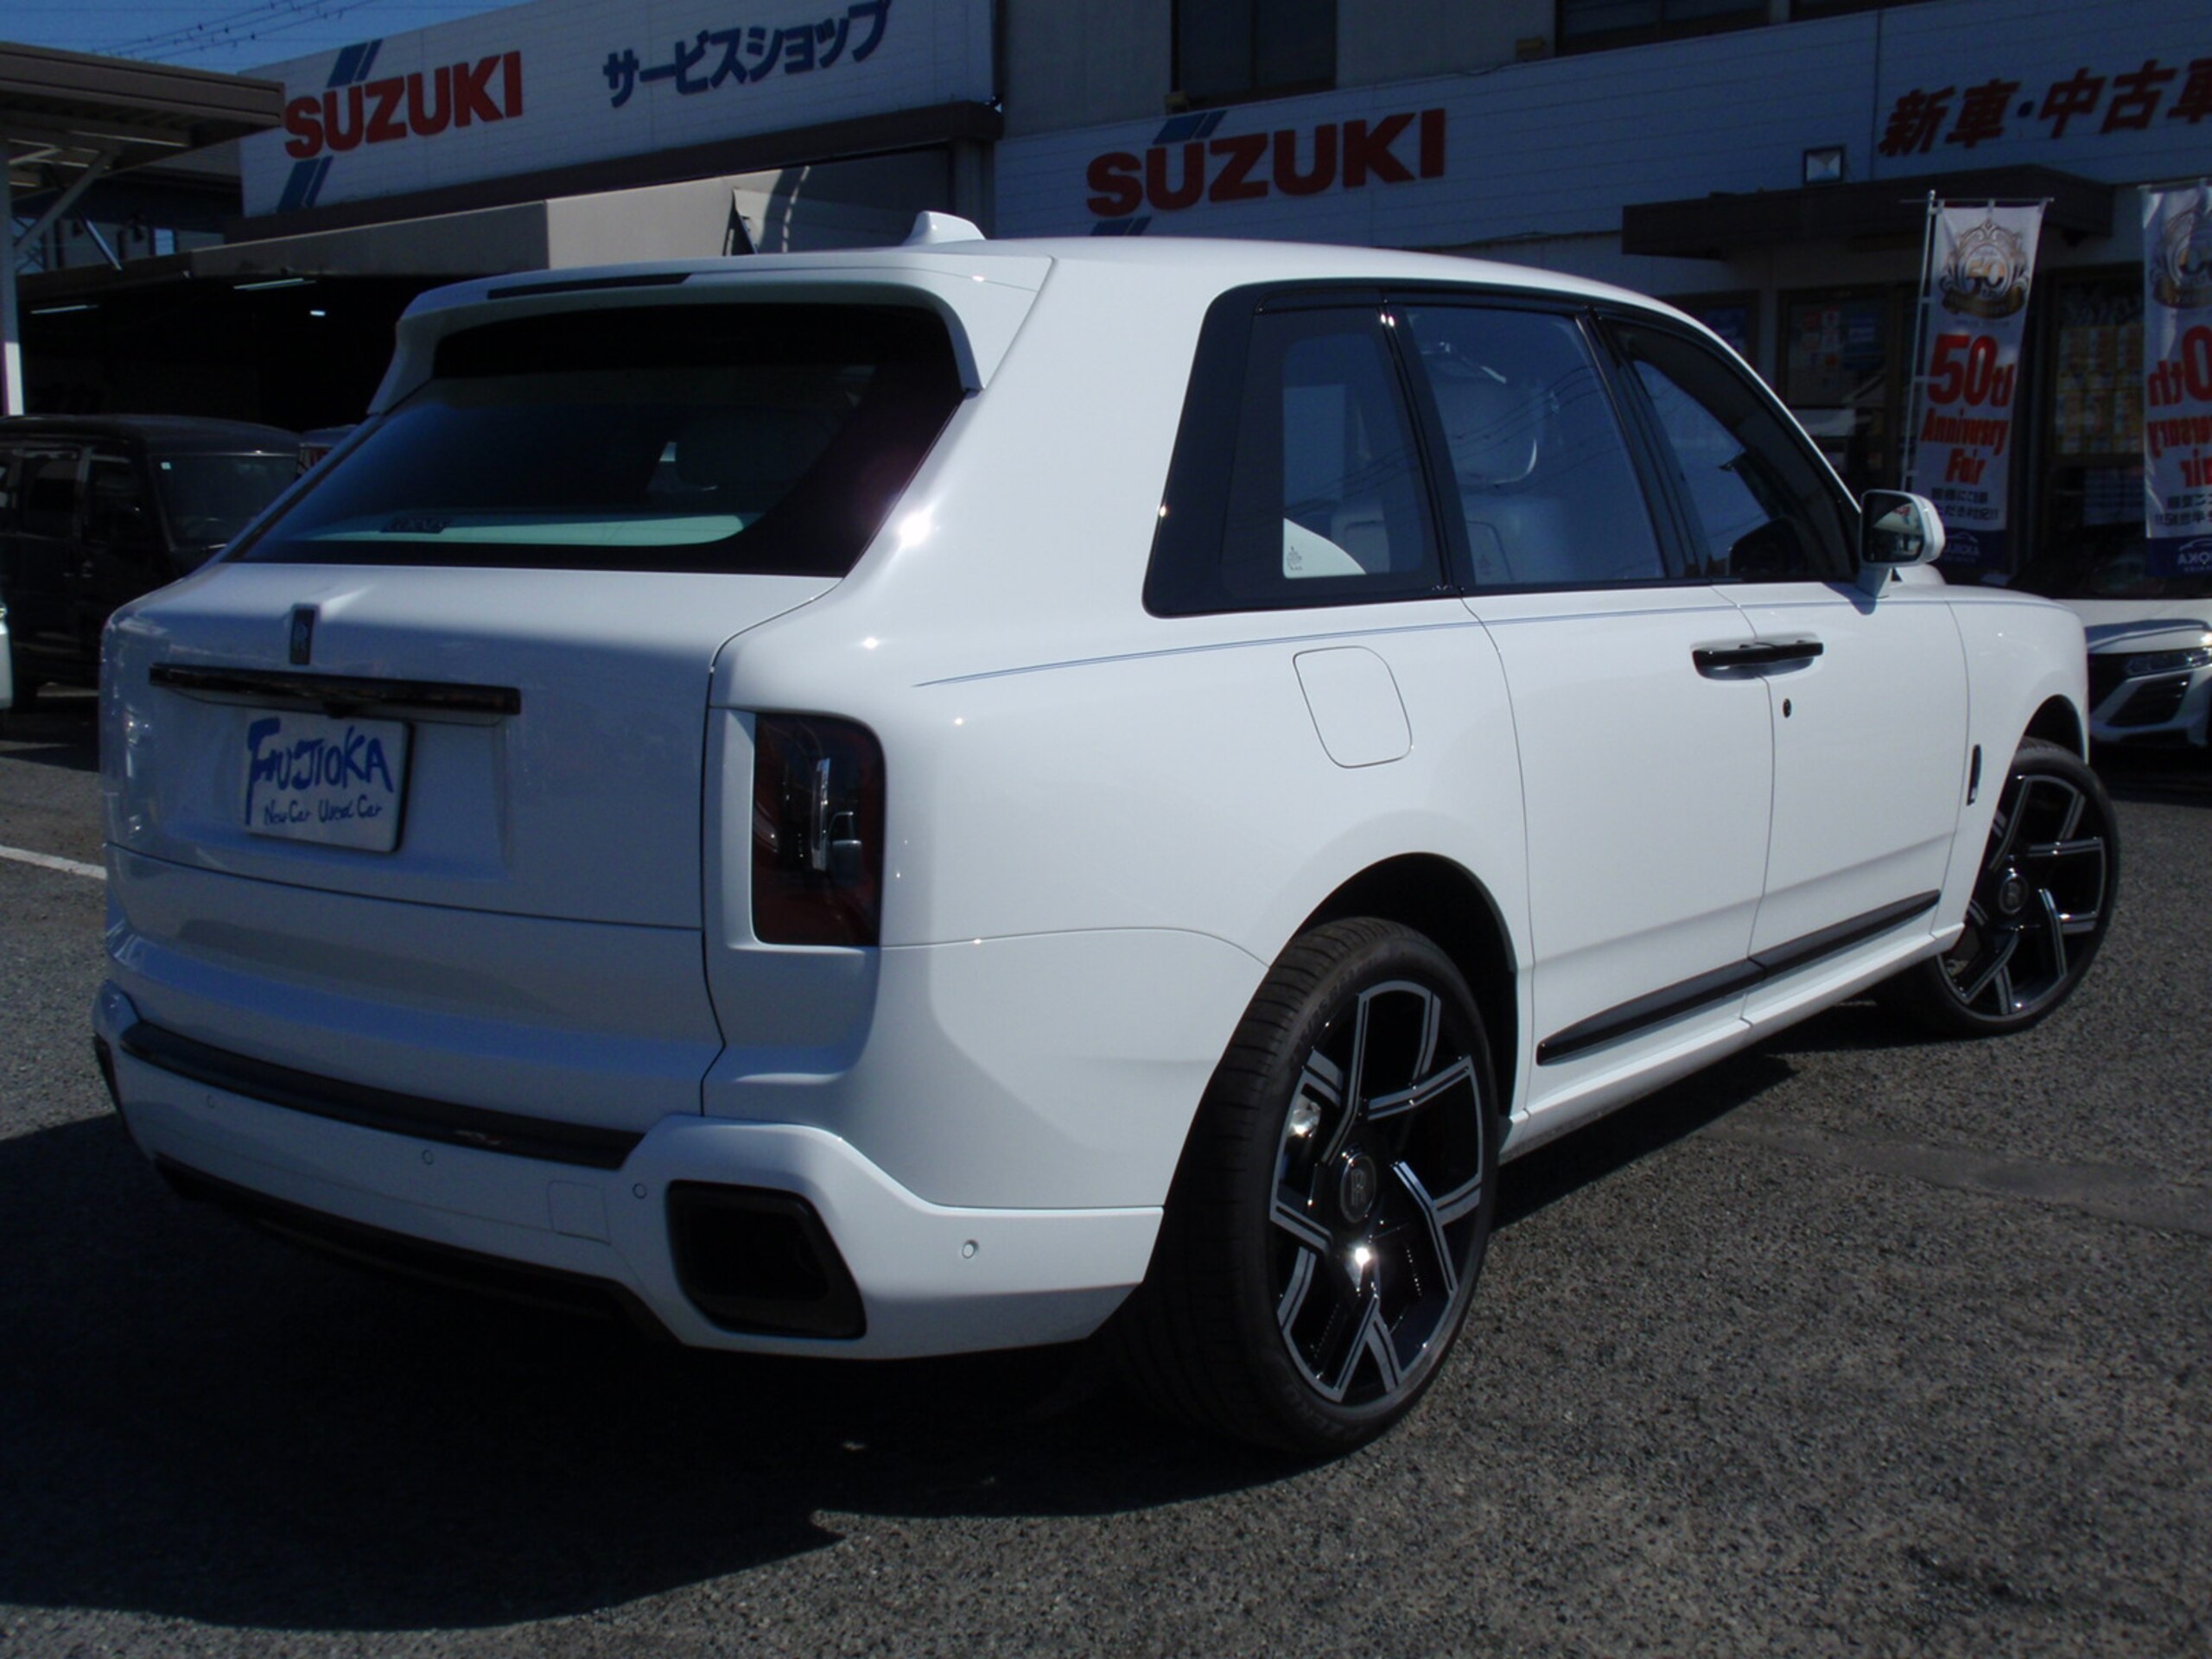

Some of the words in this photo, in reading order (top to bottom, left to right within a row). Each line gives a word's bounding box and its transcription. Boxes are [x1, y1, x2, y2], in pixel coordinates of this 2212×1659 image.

[284, 50, 523, 159] SUZUKI
[603, 0, 892, 108] サービスショップ
[1086, 108, 1446, 217] SUZUKI
[245, 717, 394, 826] FUJIOKA
[289, 800, 311, 823] Car
[357, 794, 383, 818] Car
